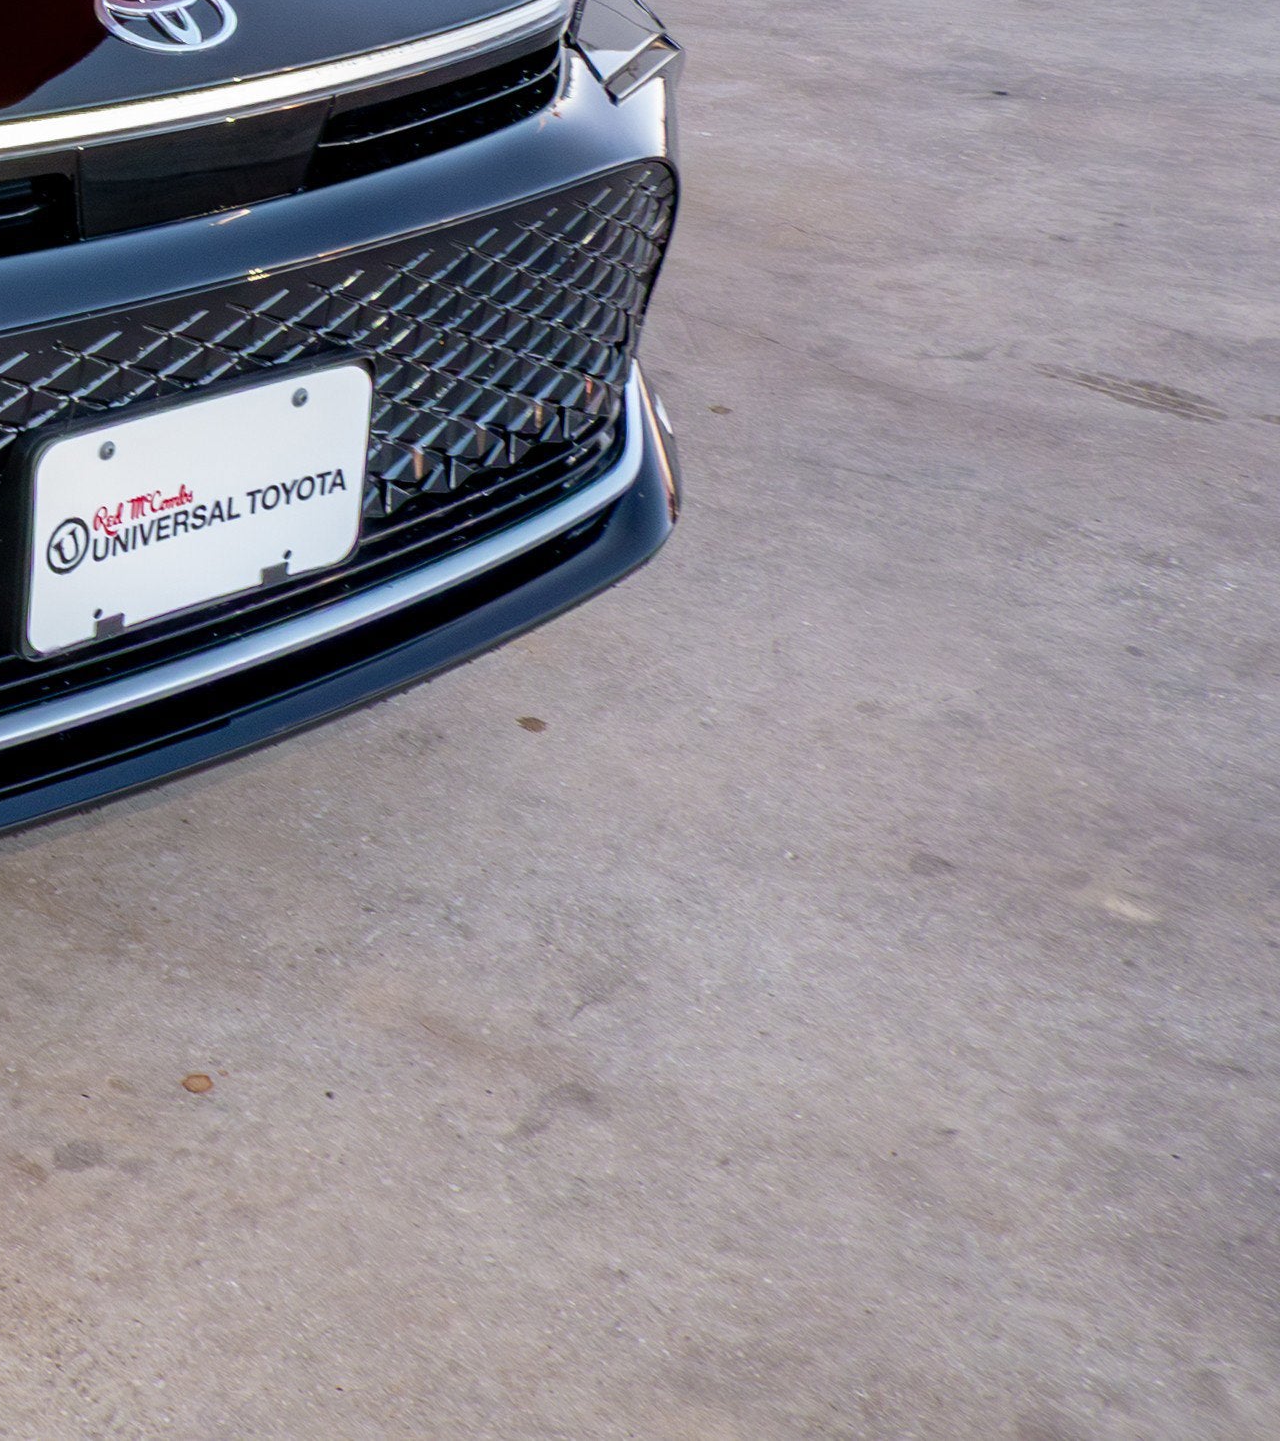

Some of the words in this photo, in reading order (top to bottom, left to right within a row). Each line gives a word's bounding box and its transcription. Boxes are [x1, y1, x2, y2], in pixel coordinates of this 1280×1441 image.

[91, 496, 240, 562] UNIVERSAL
[247, 468, 347, 515] TOYOTA
[93, 502, 124, 537] Red
